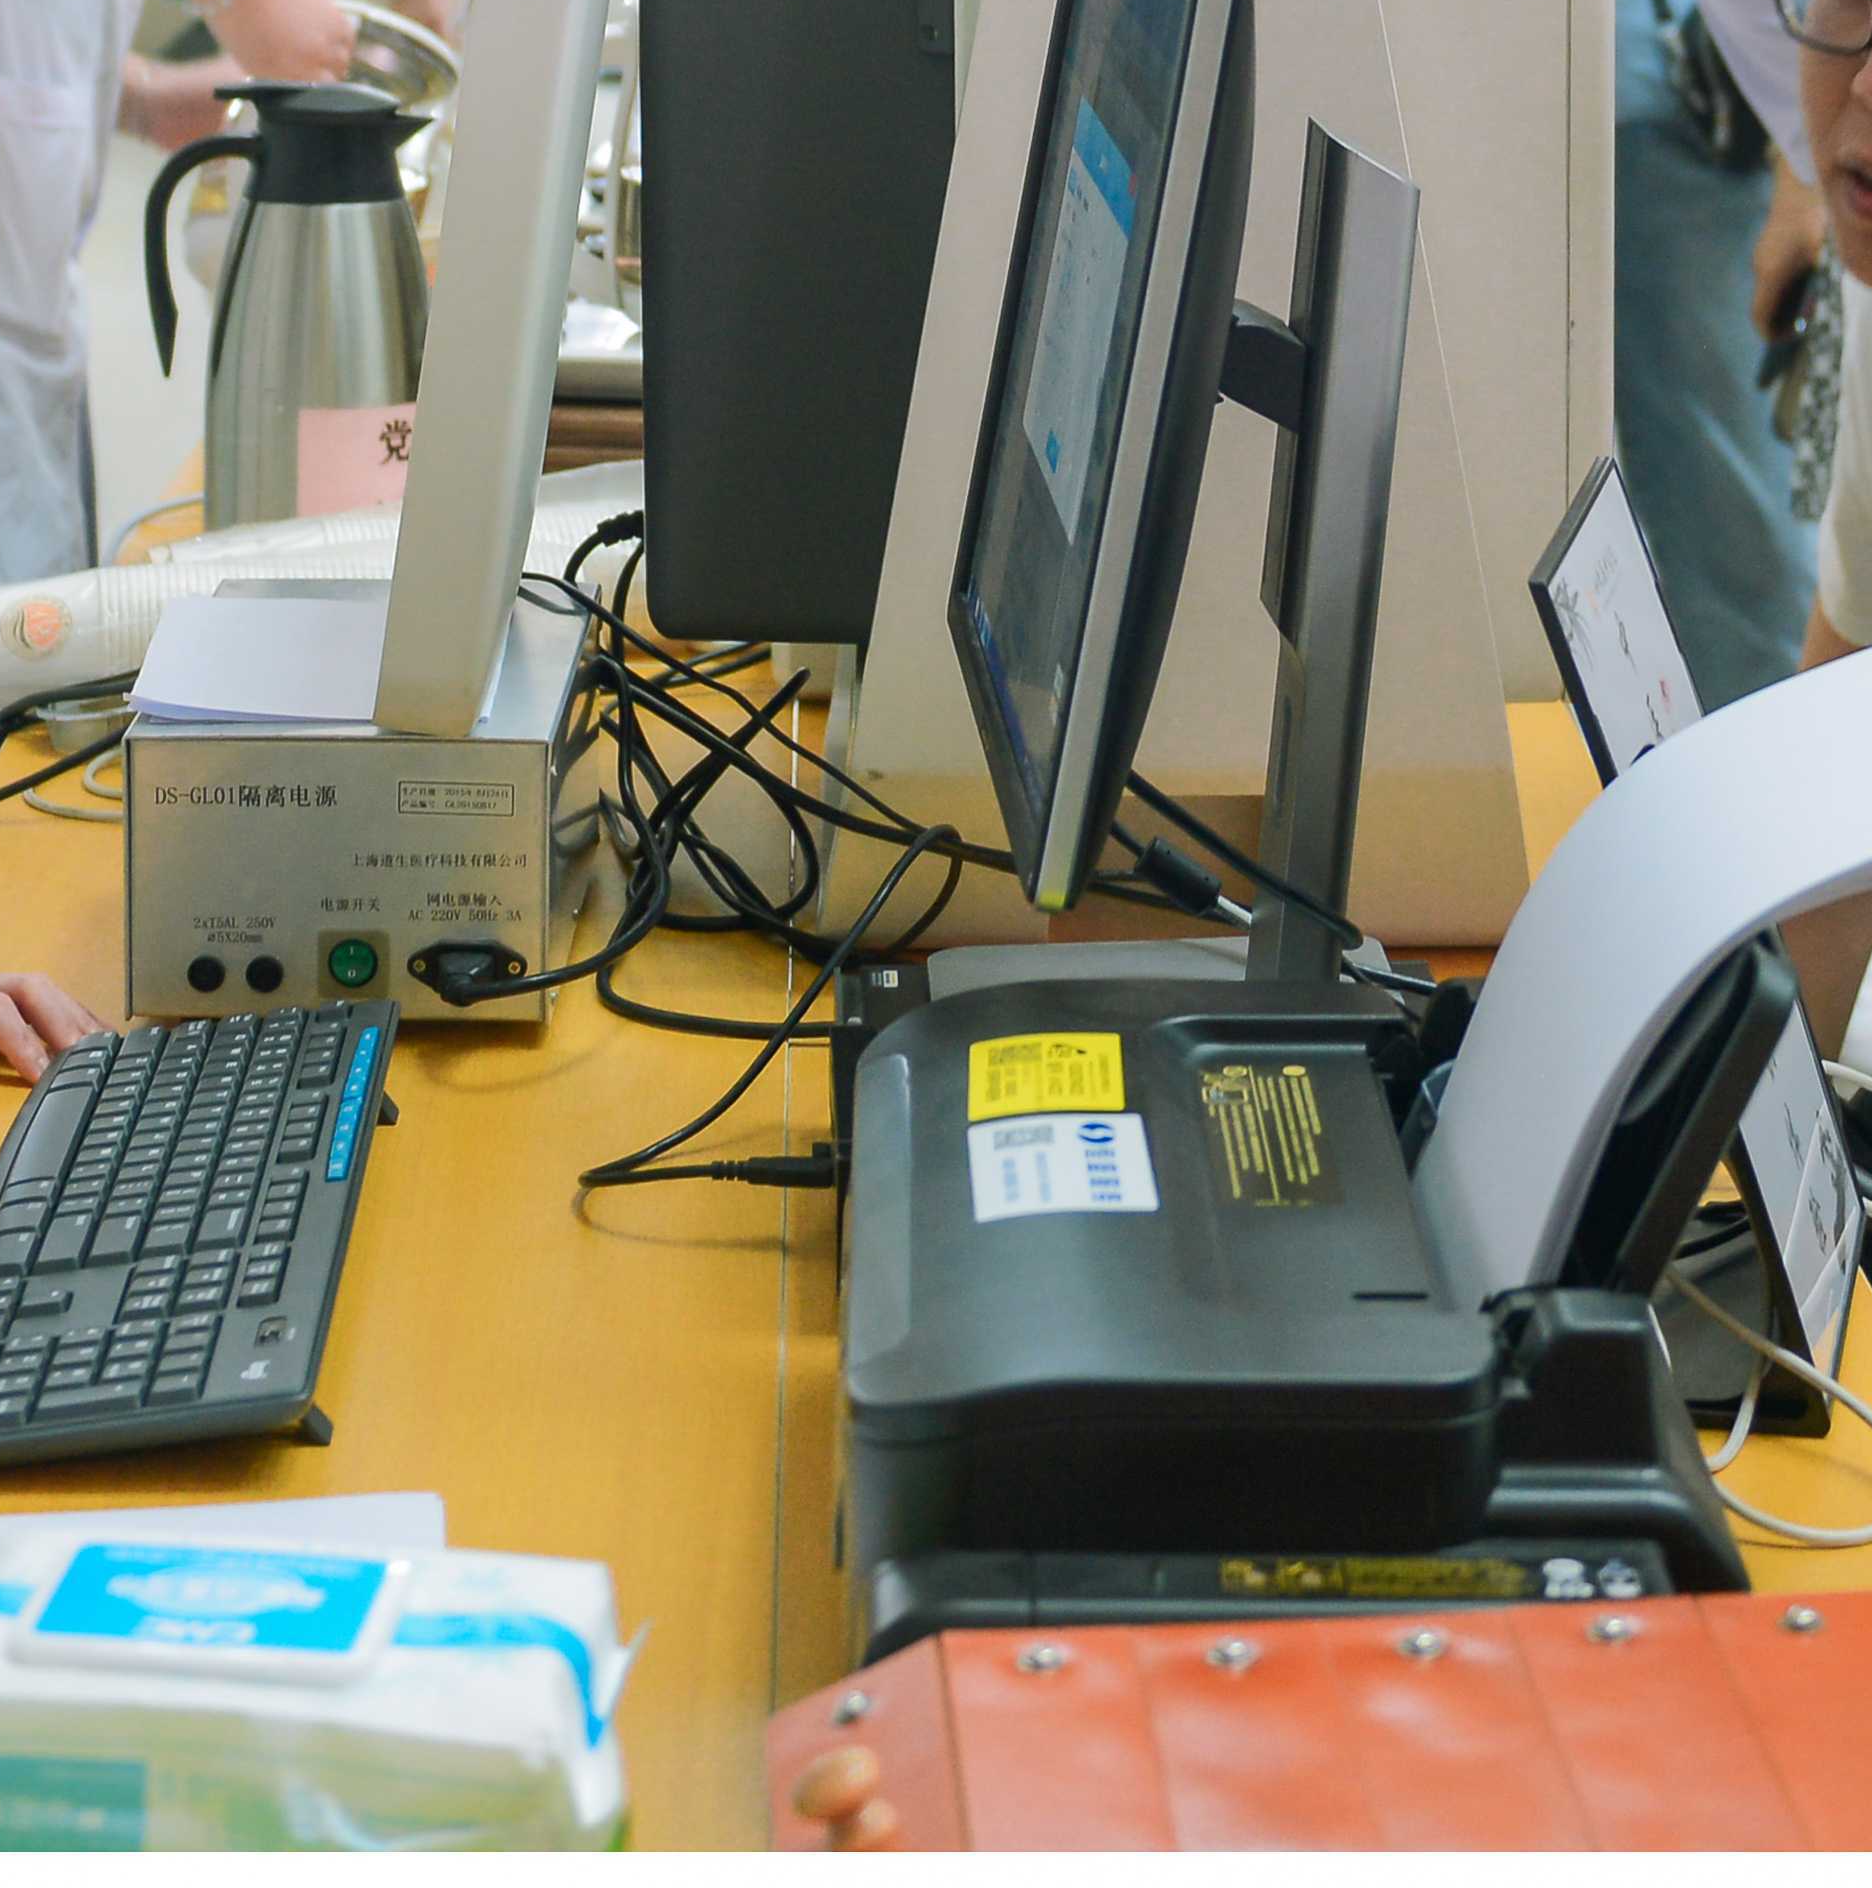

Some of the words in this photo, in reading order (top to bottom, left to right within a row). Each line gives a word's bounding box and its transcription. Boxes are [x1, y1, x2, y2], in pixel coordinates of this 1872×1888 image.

[155, 784, 338, 808] DS-GL01隔离电源
[320, 896, 380, 912] 电源开关
